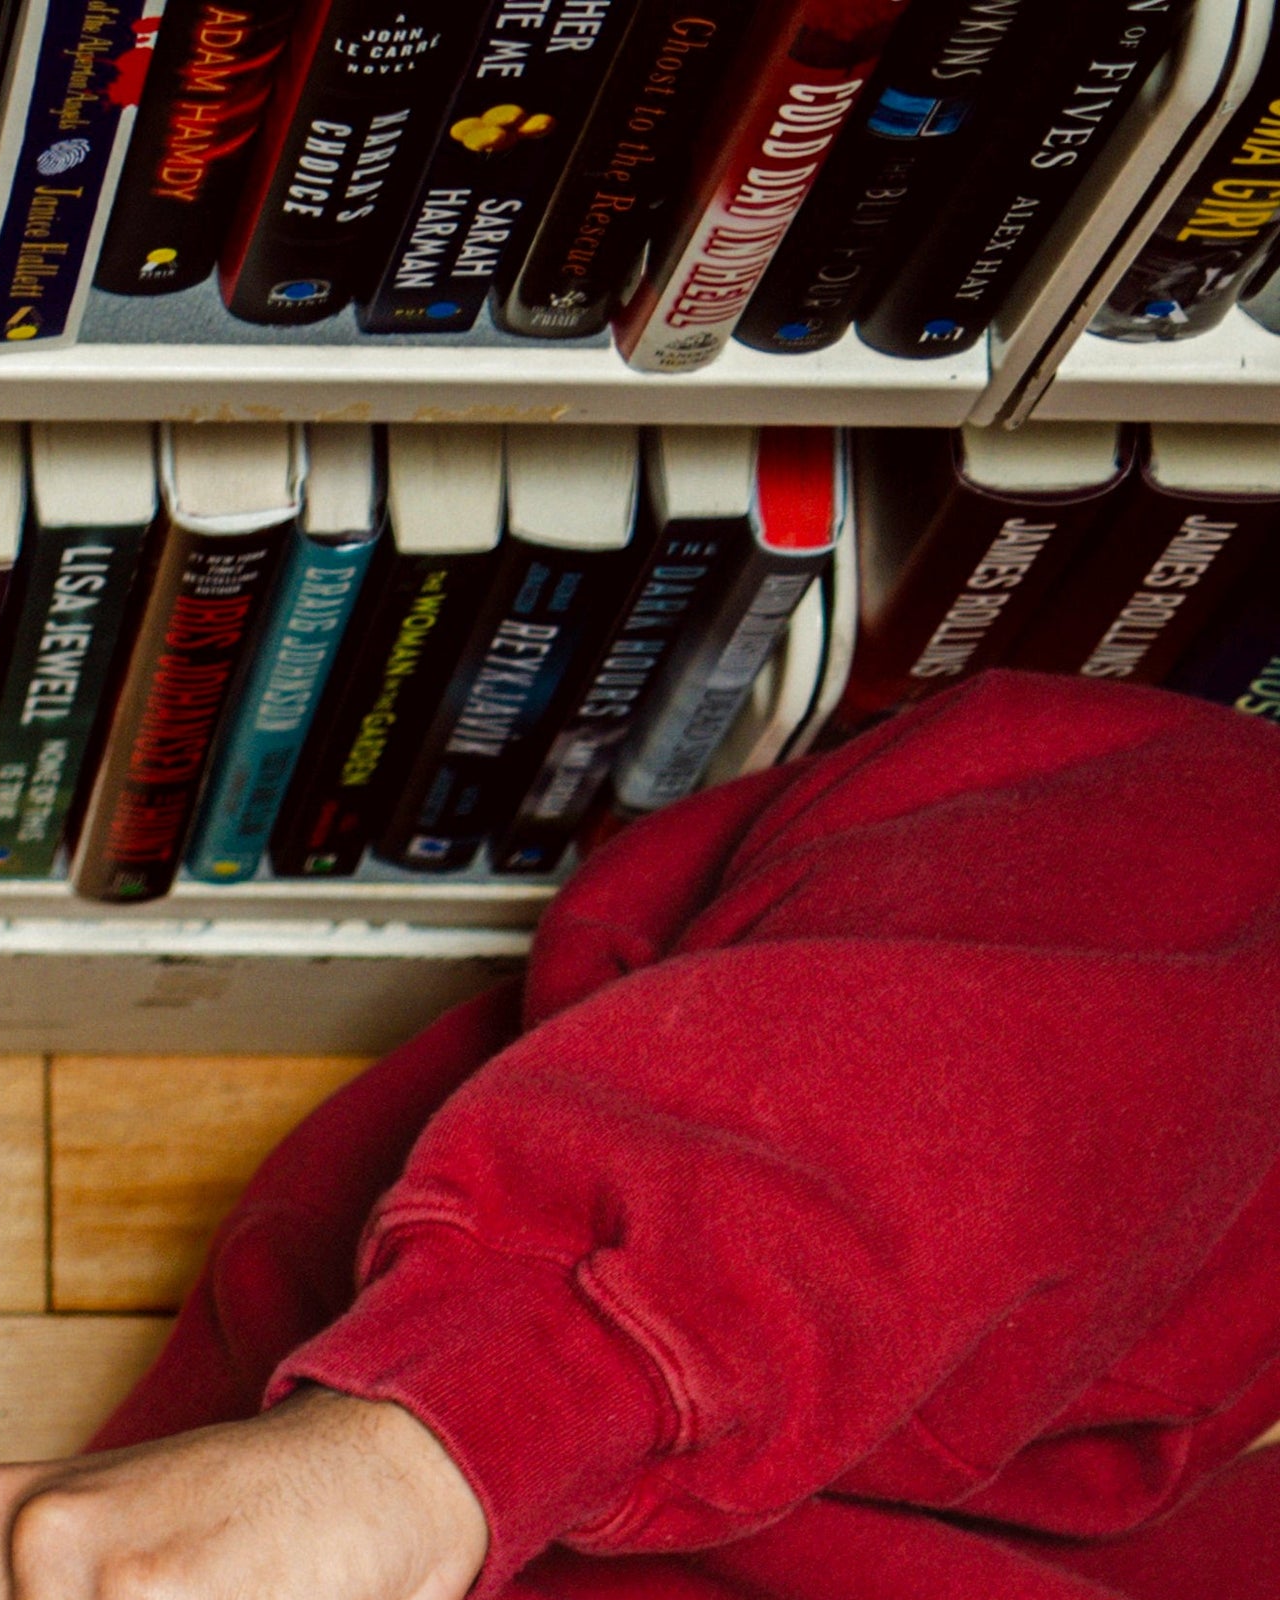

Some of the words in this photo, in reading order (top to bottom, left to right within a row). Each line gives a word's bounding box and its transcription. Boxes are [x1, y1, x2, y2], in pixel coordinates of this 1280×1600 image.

[181, 6, 249, 93] ADAM
[334, 38, 358, 57] LE
[362, 27, 423, 43] JOHN
[396, 14, 406, 24] A
[1120, 27, 1147, 49] OF
[347, 61, 416, 75] NOVEL
[476, 40, 532, 78] ME
[644, 17, 716, 96] Ghost
[629, 106, 666, 131] to
[762, 78, 863, 158] COLD
[1031, 61, 1138, 169] FIVES
[152, 102, 218, 203] HAMDY
[283, 119, 353, 218] CHOICE
[336, 108, 411, 223] KARLA'S
[605, 140, 655, 182] the
[25, 185, 83, 238] Janice
[724, 162, 818, 219] DAY
[984, 196, 1040, 252] ALEX
[1176, 179, 1280, 242] GIRL
[394, 189, 472, 289] HARMAN
[450, 198, 523, 277] SARAH
[561, 190, 636, 276] Rescue
[705, 221, 788, 257] IN
[10, 242, 68, 298] Hallett
[666, 258, 769, 328] HELL
[956, 259, 1003, 300] HAY
[47, 544, 115, 614] LISA
[667, 542, 717, 557] THE
[967, 517, 1058, 590] JAMES
[1143, 514, 1238, 589] JAMES
[166, 595, 252, 649] IRIS
[289, 565, 356, 633] CRAIG
[624, 565, 708, 632] DARK
[385, 594, 446, 679] WOMAN
[909, 593, 1011, 679] ROLLINS
[1080, 592, 1187, 678] ROLLINS
[21, 616, 94, 726] JEWELL
[254, 636, 326, 732] JOHNSON
[578, 639, 666, 718] HOURS
[129, 654, 231, 784] JOHANSEN
